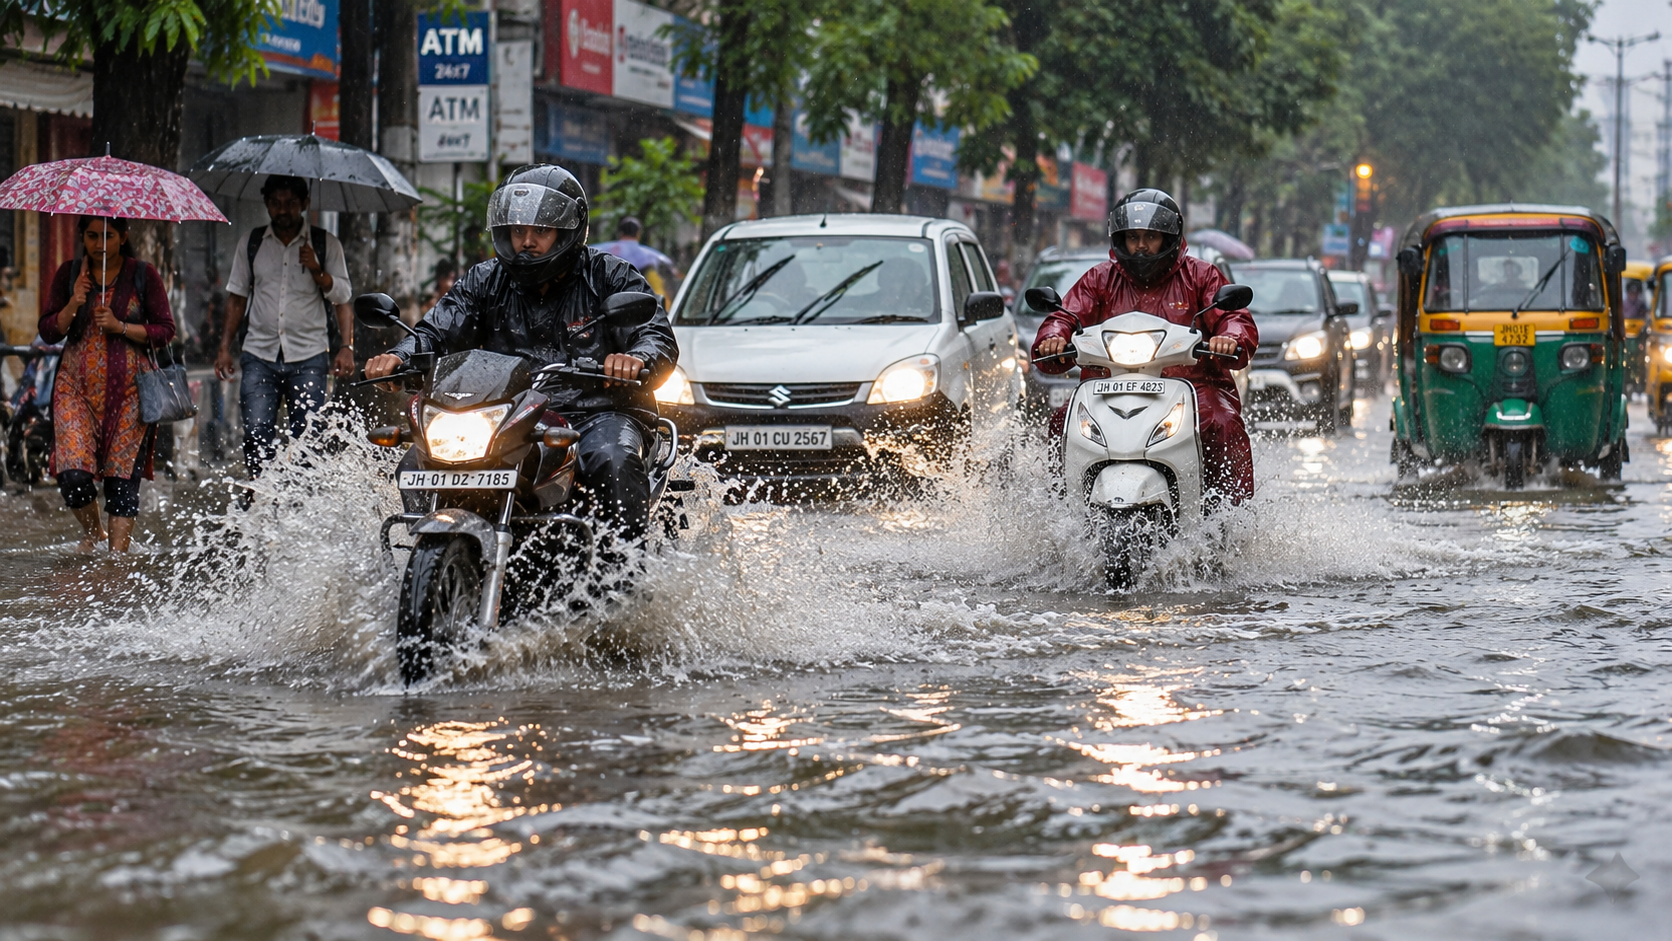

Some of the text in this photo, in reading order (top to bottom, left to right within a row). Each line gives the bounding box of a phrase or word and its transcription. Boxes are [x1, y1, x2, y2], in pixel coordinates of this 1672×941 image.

[420, 27, 483, 56] ATM
[428, 96, 480, 121] ATM
[1096, 382, 1110, 392] JH
[1112, 382, 1123, 392] 01
[1126, 382, 1137, 391] EF
[732, 431, 827, 446] JH 01 CU 2567
